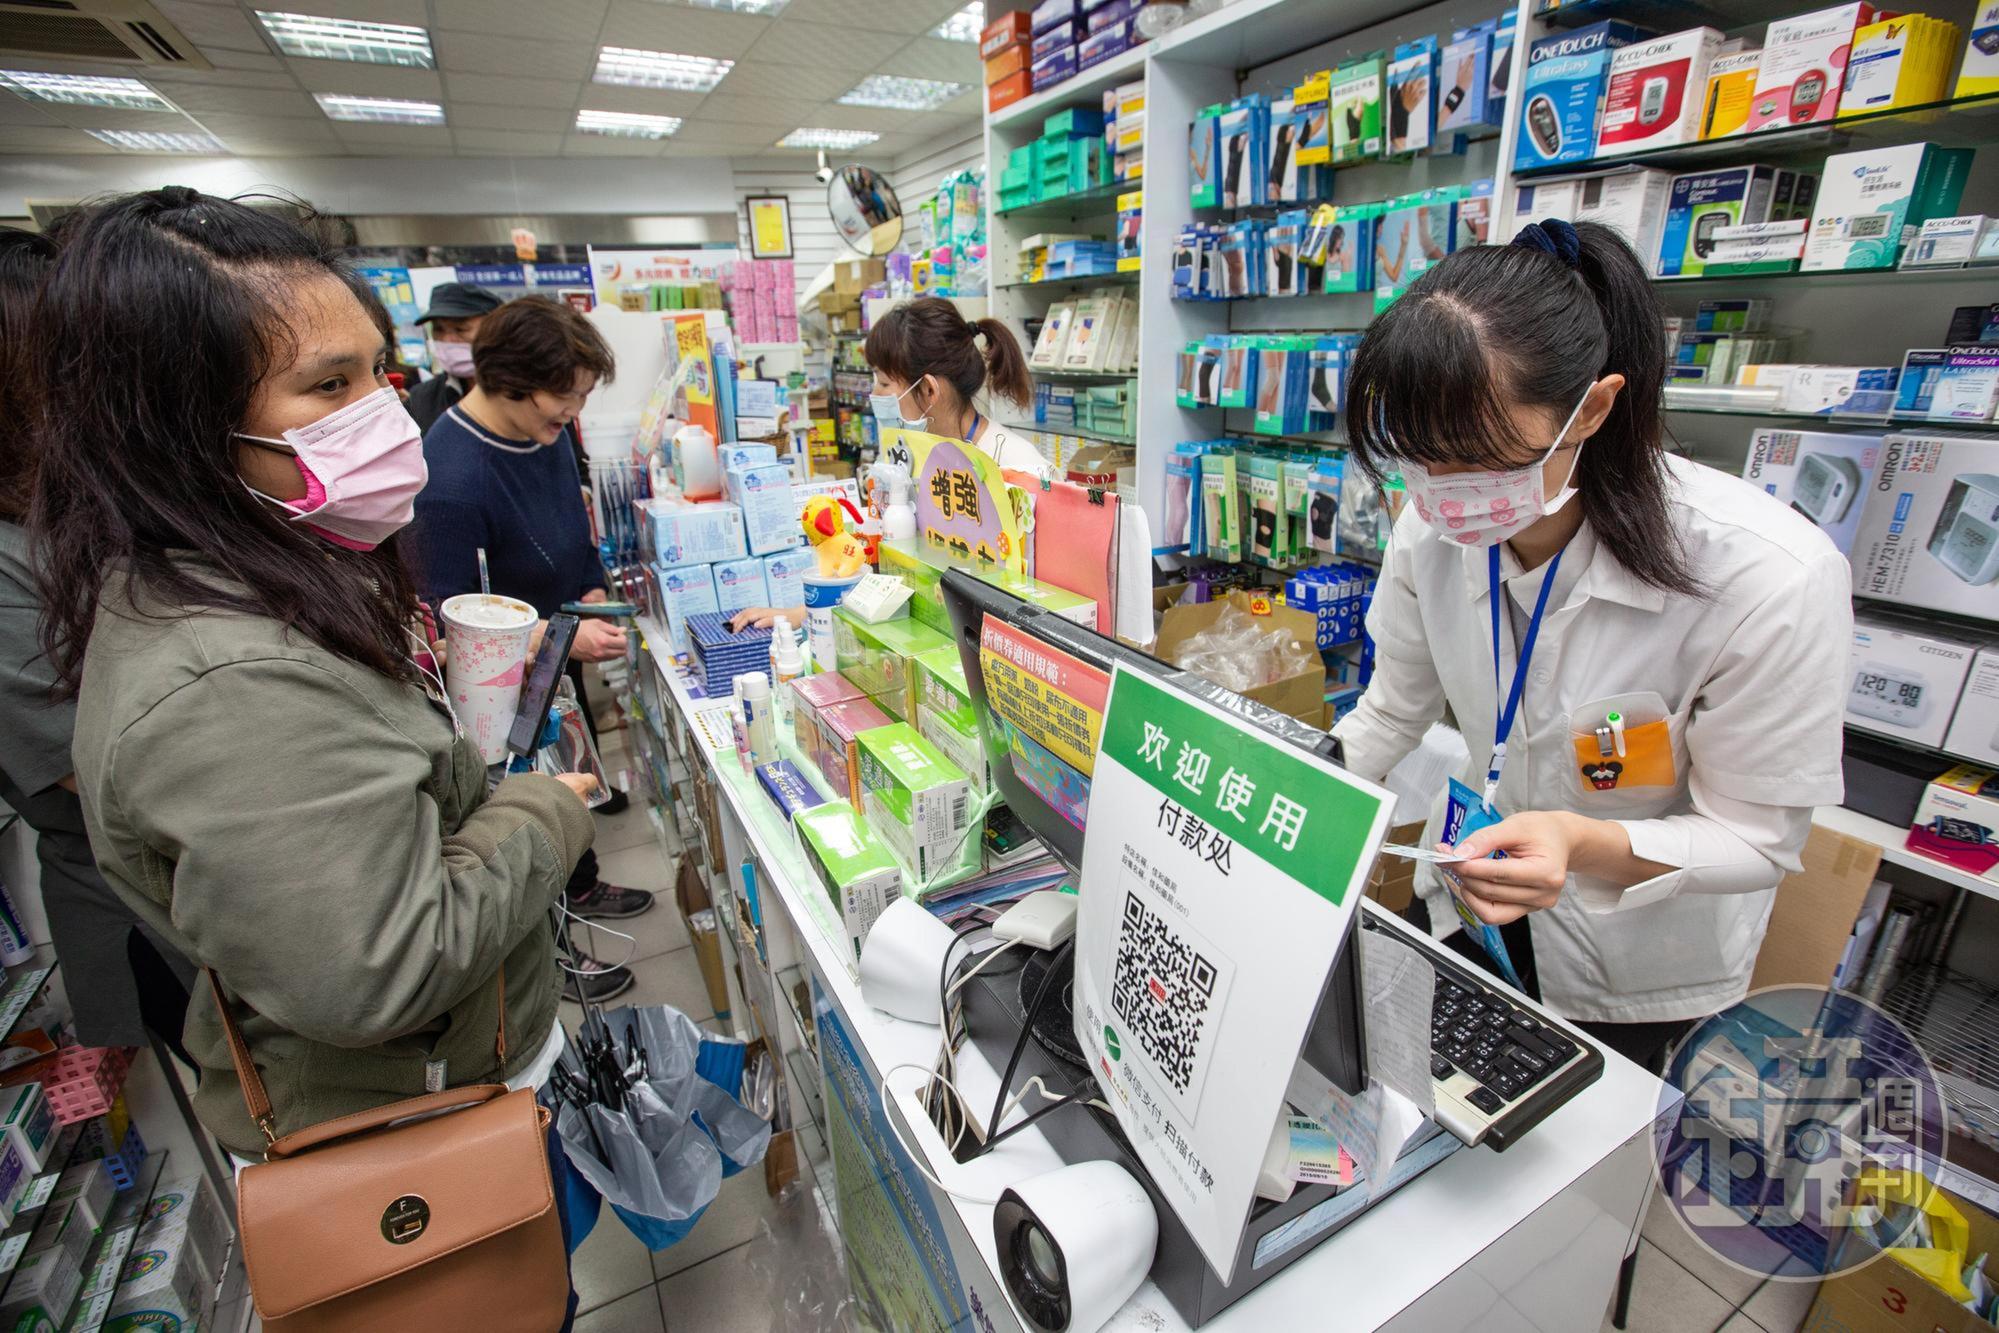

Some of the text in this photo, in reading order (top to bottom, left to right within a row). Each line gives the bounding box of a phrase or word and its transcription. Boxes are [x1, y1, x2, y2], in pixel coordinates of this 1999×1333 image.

[1614, 42, 1673, 64] ACCU-CHEK
[1870, 533, 1900, 594] HEM-7310
[1919, 645, 1964, 660] CITIZEN
[1136, 720, 1308, 852] 欢迎使用
[1156, 798, 1233, 876] 付款处
[1123, 1062, 1214, 1194] 微信支付 扫描付款
